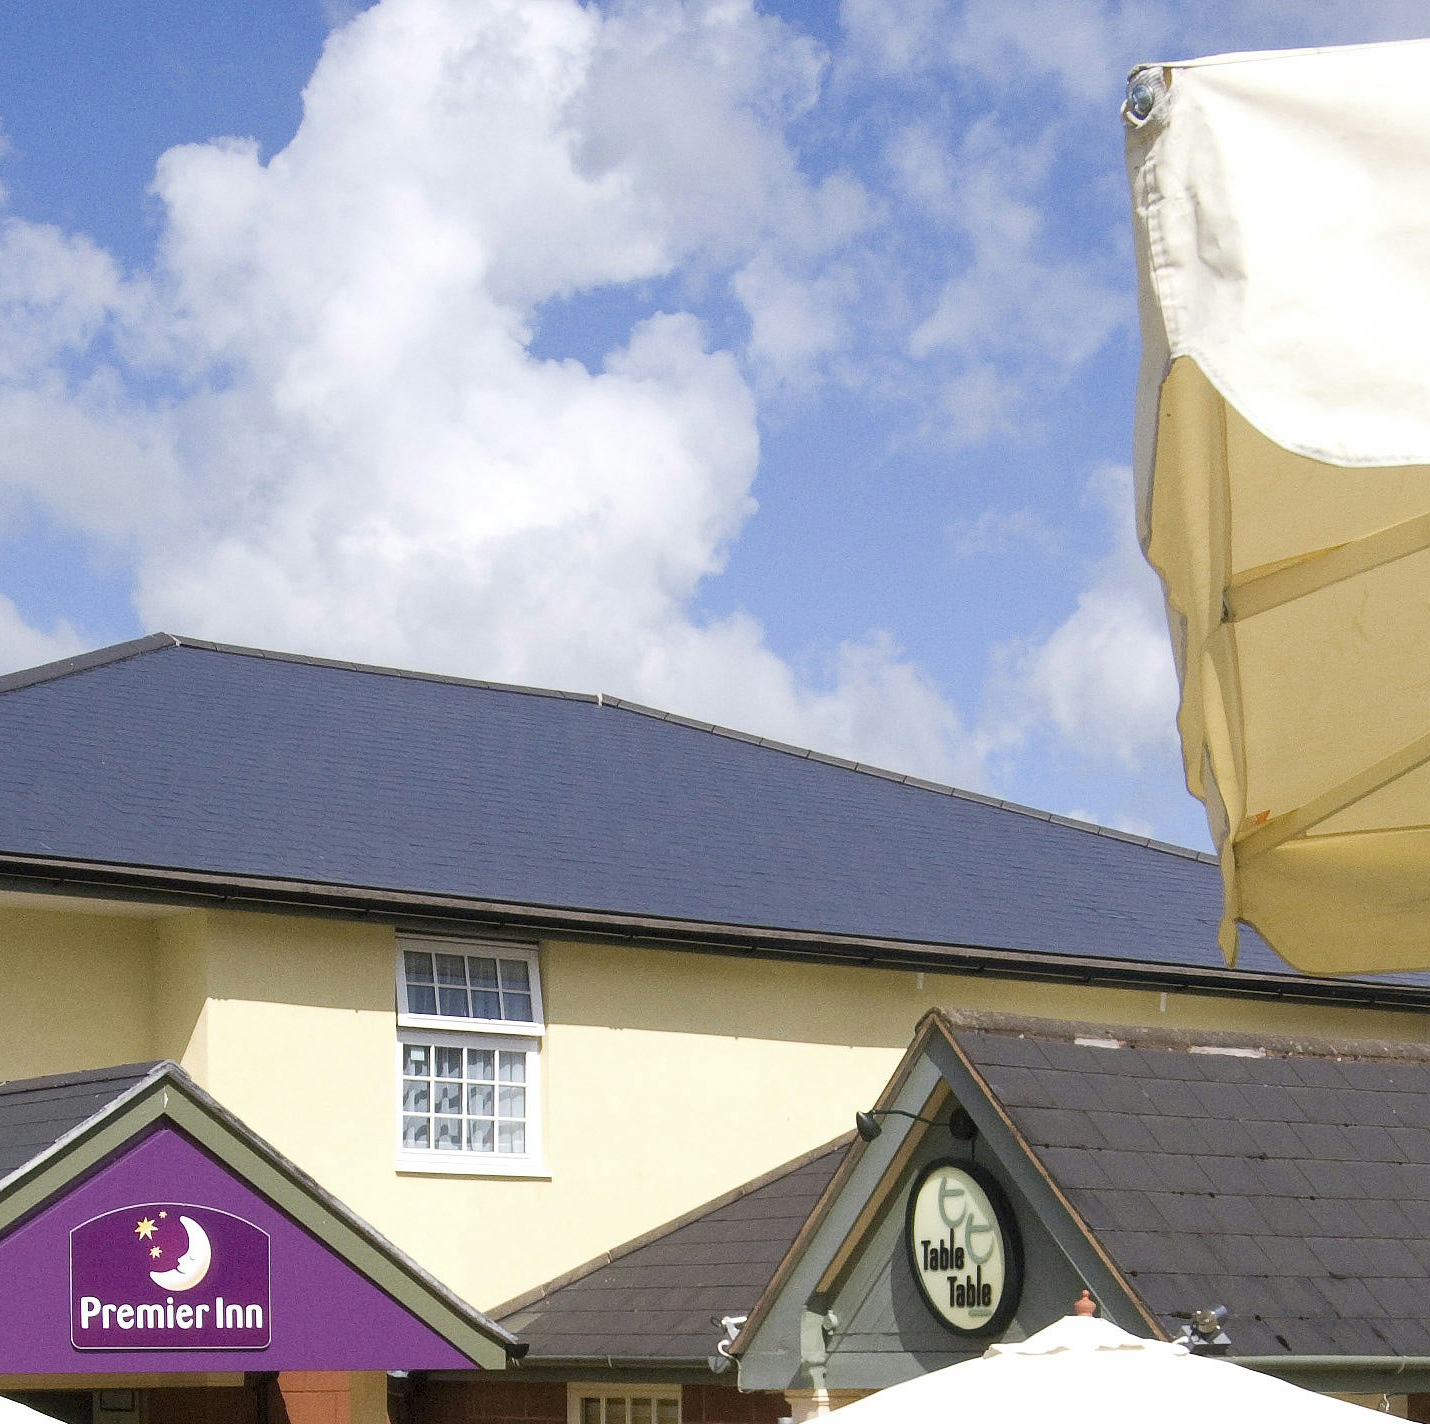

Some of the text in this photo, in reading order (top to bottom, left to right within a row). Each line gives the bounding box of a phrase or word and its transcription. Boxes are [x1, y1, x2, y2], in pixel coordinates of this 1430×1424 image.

[921, 1228, 965, 1271] Table
[947, 1265, 991, 1308] Table
[80, 1296, 263, 1329] Premier Inn
